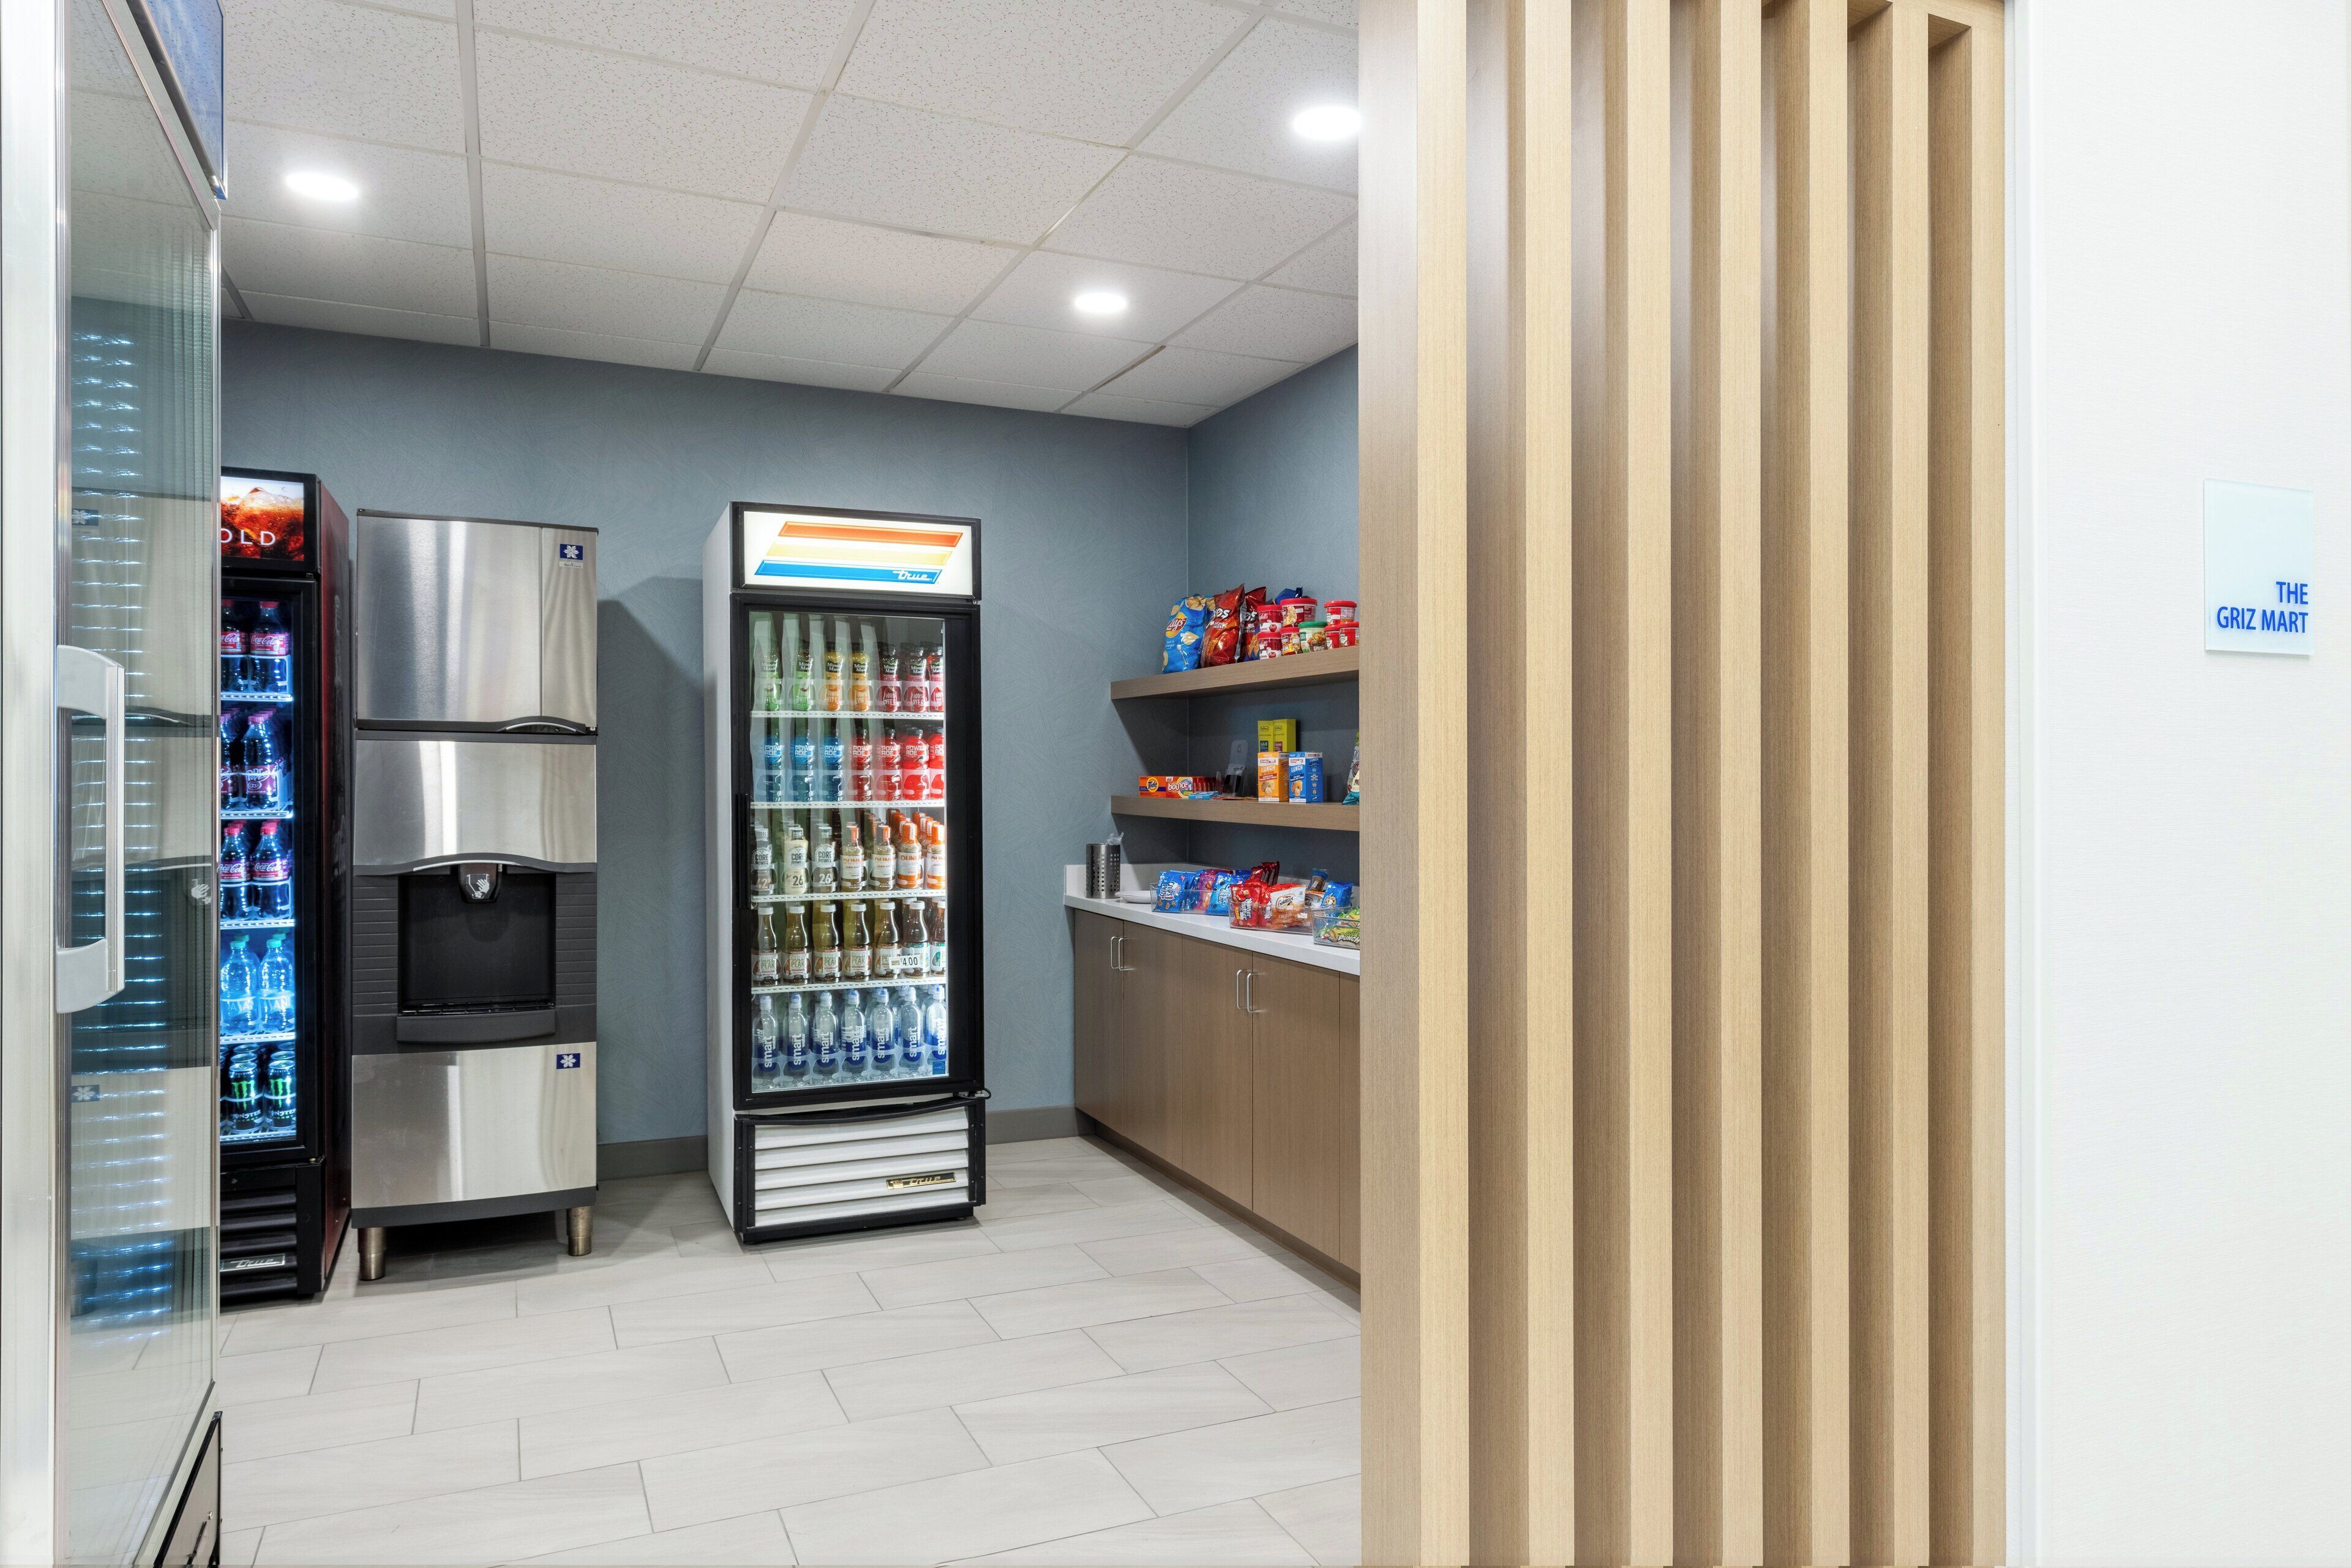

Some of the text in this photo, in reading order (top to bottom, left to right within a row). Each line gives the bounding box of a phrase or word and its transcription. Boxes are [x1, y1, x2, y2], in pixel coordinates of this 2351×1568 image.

[221, 528, 276, 546] OLD
[2276, 581, 2308, 604] THE
[1166, 619, 1185, 631] Lay's
[2217, 606, 2308, 633] GRIZ MART
[1291, 764, 1303, 773] LUNCH
[1168, 782, 1188, 790] bounce
[220, 863, 245, 873] oca-Cola
[819, 873, 831, 883] 26
[792, 875, 803, 886] 26
[764, 1036, 773, 1068] smart
[793, 1033, 801, 1065] smart
[821, 1032, 830, 1063] smart
[877, 1028, 885, 1059] smart
[909, 1027, 917, 1058] smart
